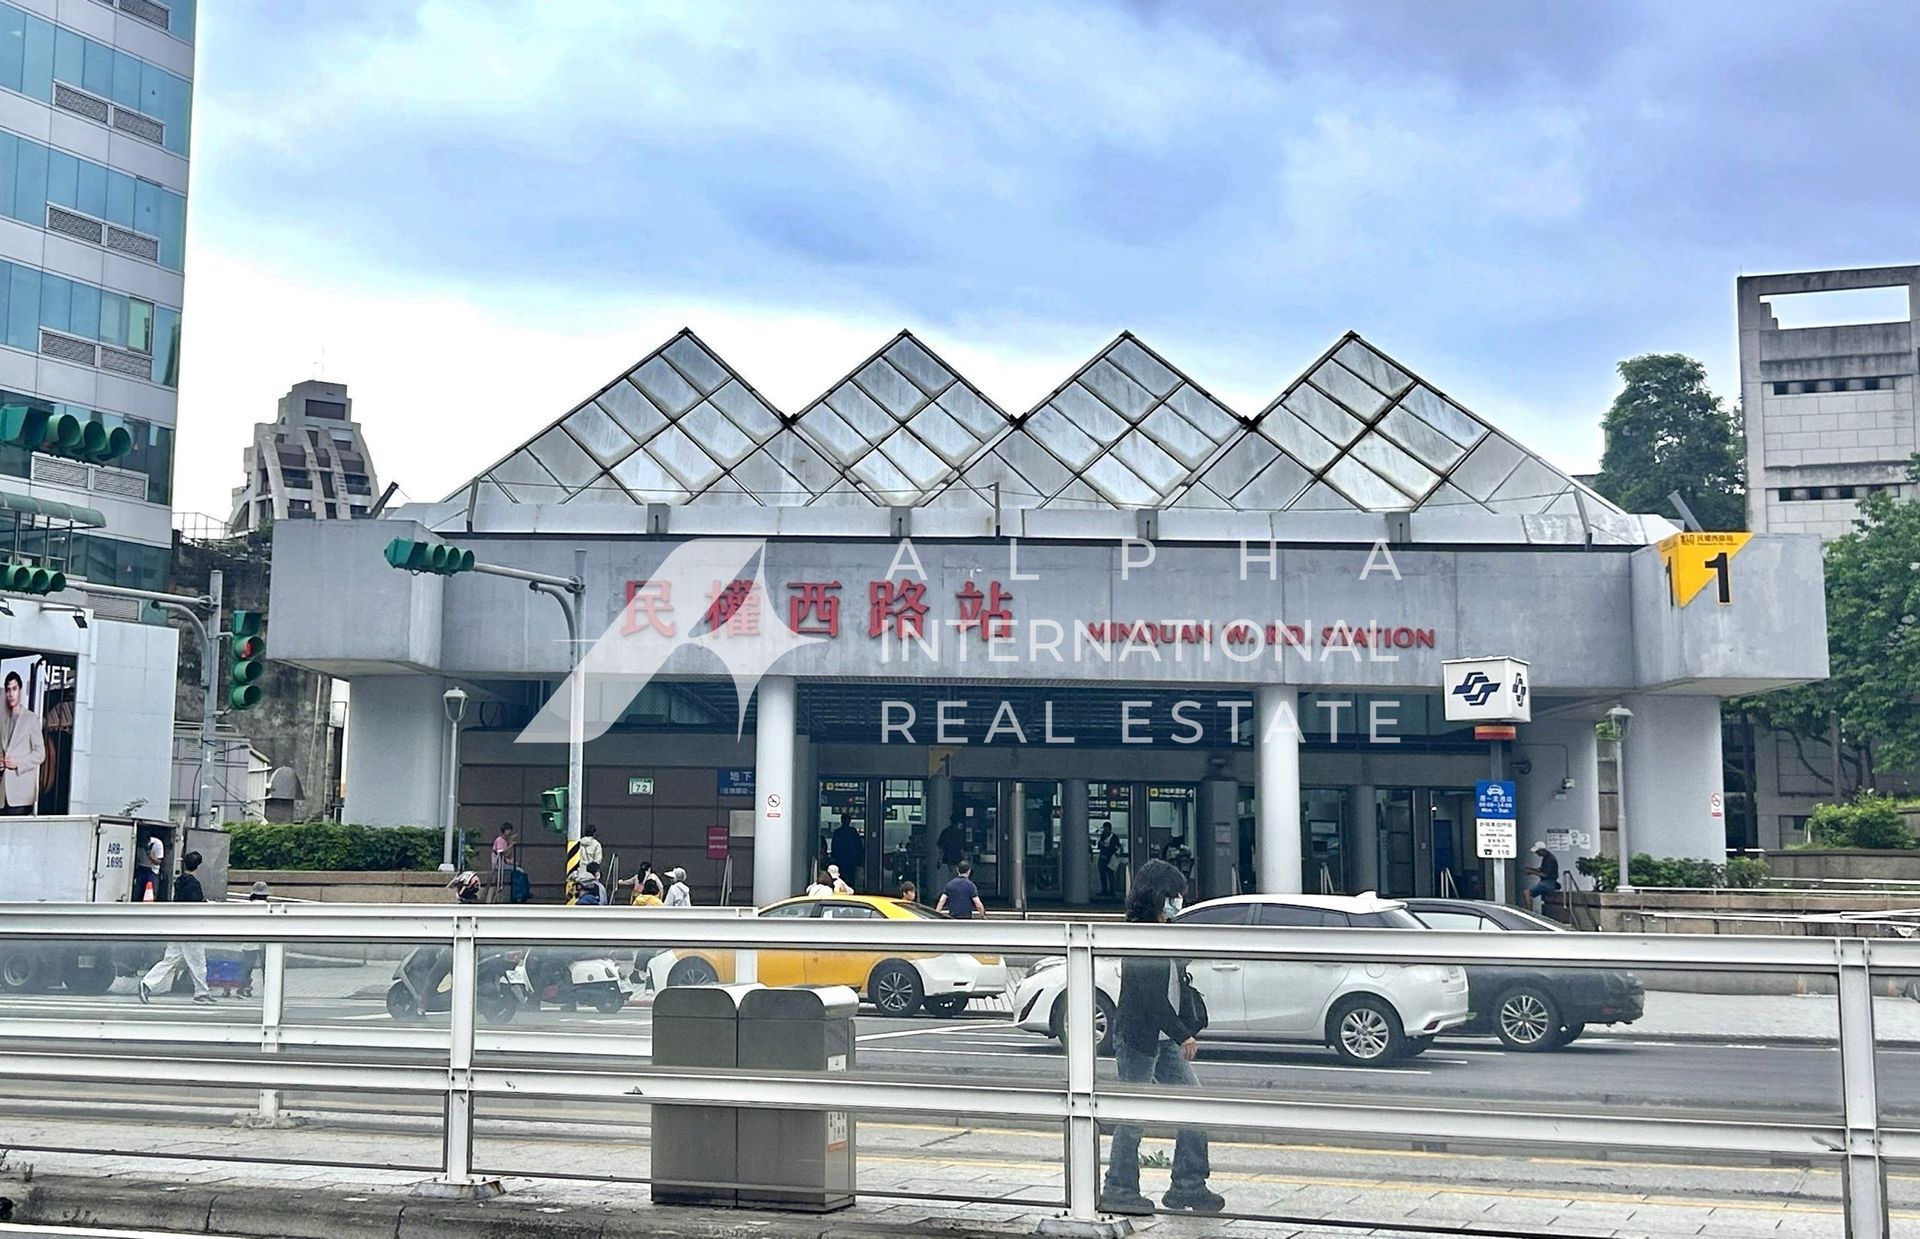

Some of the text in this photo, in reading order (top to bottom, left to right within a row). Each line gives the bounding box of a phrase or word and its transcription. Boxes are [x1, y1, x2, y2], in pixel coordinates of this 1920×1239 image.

[1704, 552, 1730, 603] 1
[621, 579, 1013, 641] 民權西路站
[1087, 623, 1213, 648] MINQUAN
[1223, 624, 1255, 646] W.
[1320, 627, 1435, 649] STATION
[42, 660, 71, 684] NET
